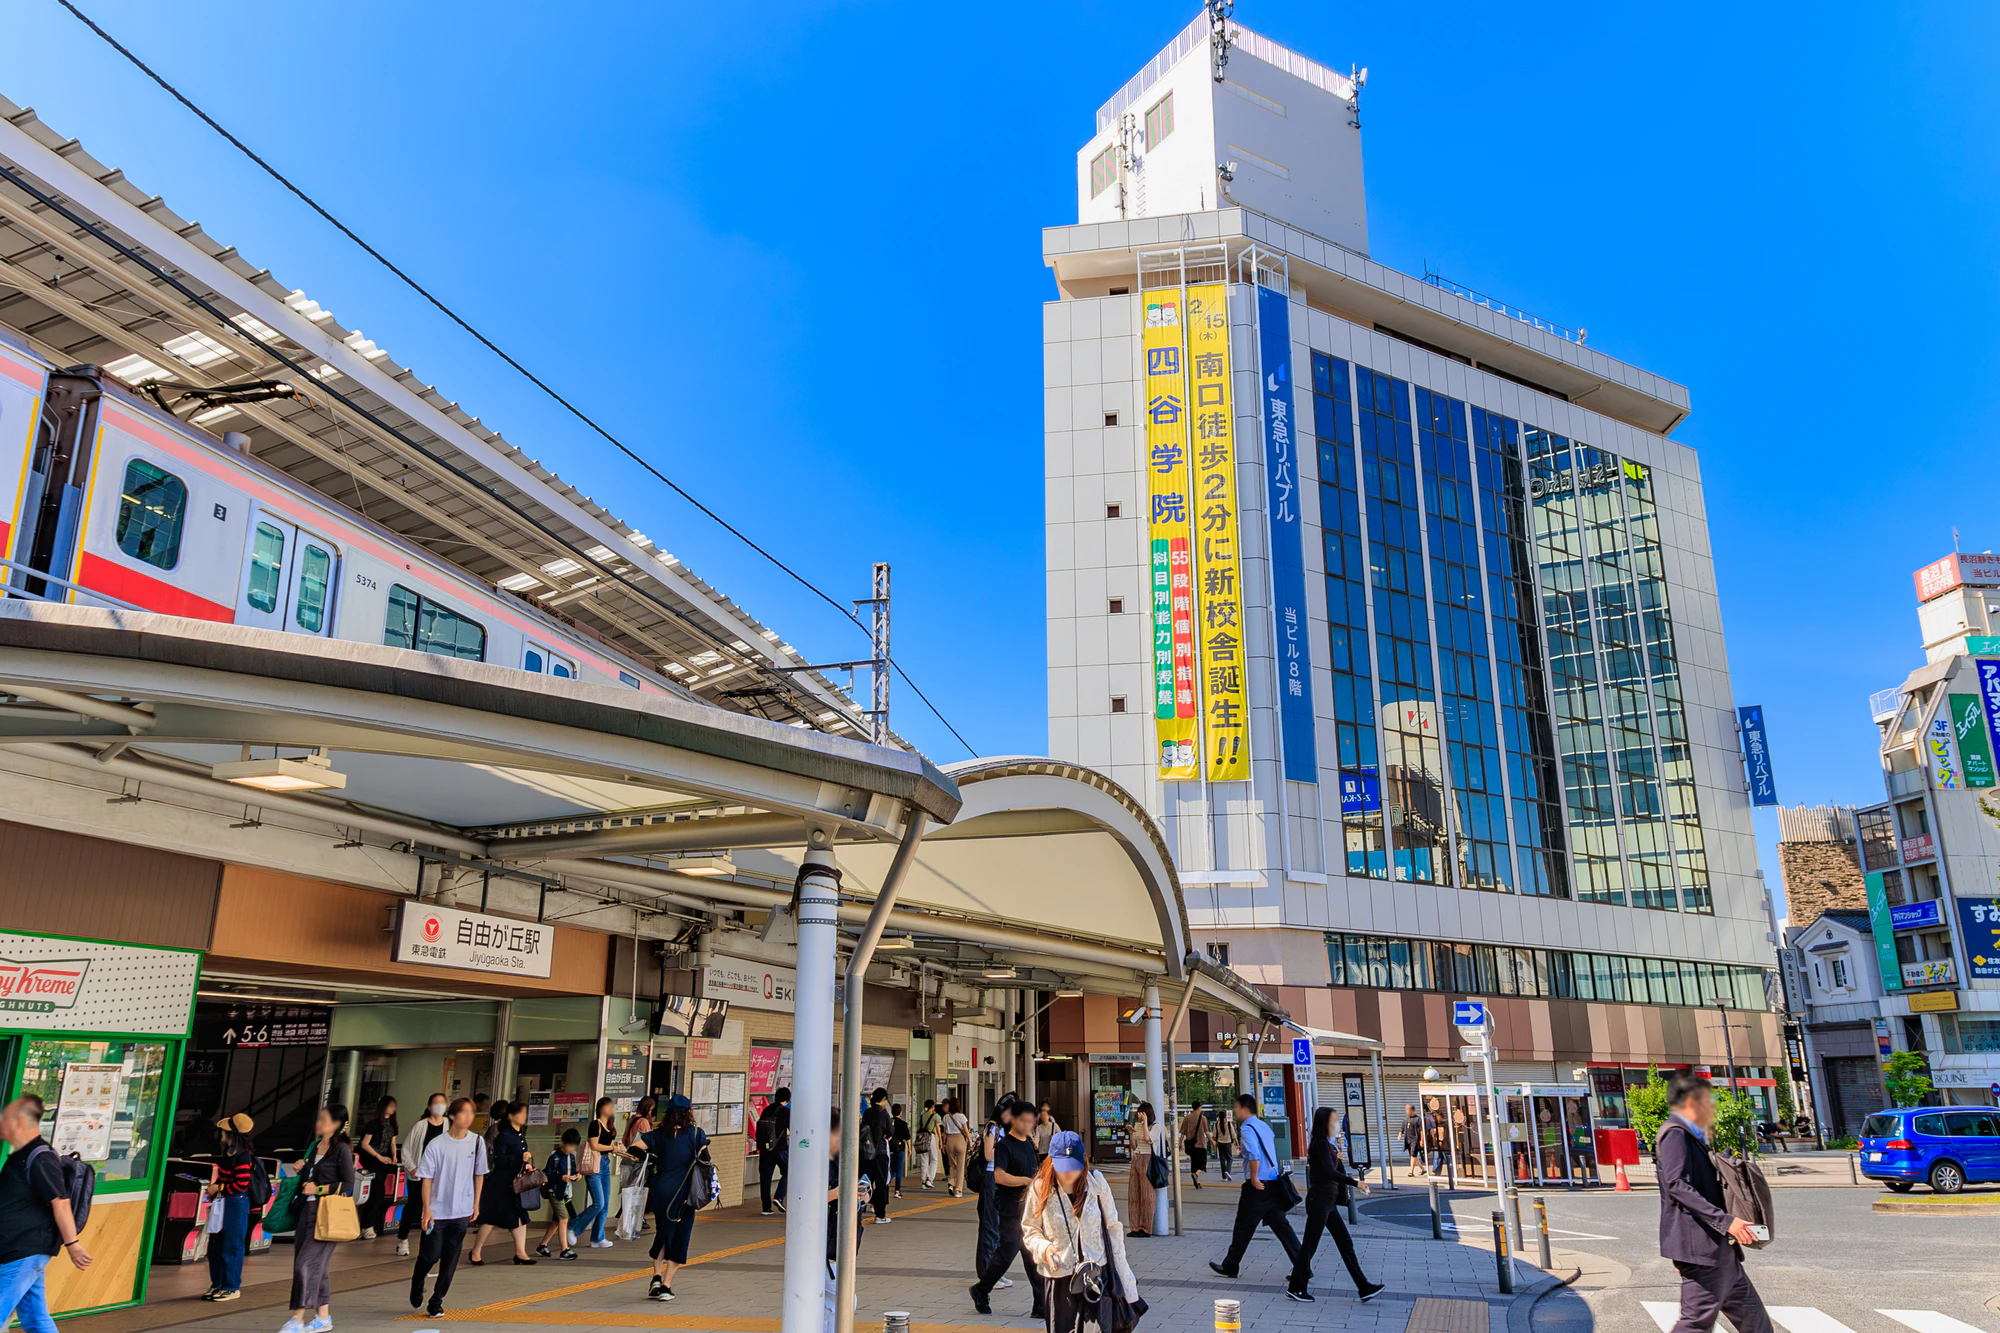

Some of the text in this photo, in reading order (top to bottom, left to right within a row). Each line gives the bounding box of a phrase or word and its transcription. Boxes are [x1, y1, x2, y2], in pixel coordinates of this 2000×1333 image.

[1147, 346, 1187, 525] 四谷学院
[1270, 397, 1295, 523] 東急リバブル
[216, 507, 225, 519] 3
[356, 573, 377, 591] 5374
[1153, 550, 1174, 706] 科目別能力別授業
[1171, 550, 1194, 705] 55段階個別指導
[1285, 606, 1303, 697] 当ビル8階
[1979, 641, 2000, 653] エイ
[1934, 720, 1948, 731] 3F
[1956, 701, 1981, 740] エイブル
[1747, 730, 1771, 796] 東急リバブル
[1930, 737, 1955, 786] ビッグ
[456, 917, 542, 955] 自由が丘駅
[411, 943, 447, 959] 東急電鉄
[469, 950, 527, 969] Jiyūgaoka Sta.
[15, 966, 81, 995] Kreme
[1906, 970, 1925, 978] 不動産の
[1924, 962, 1949, 980] ビッグ
[1934, 1073, 1968, 1084] BIGUINE
